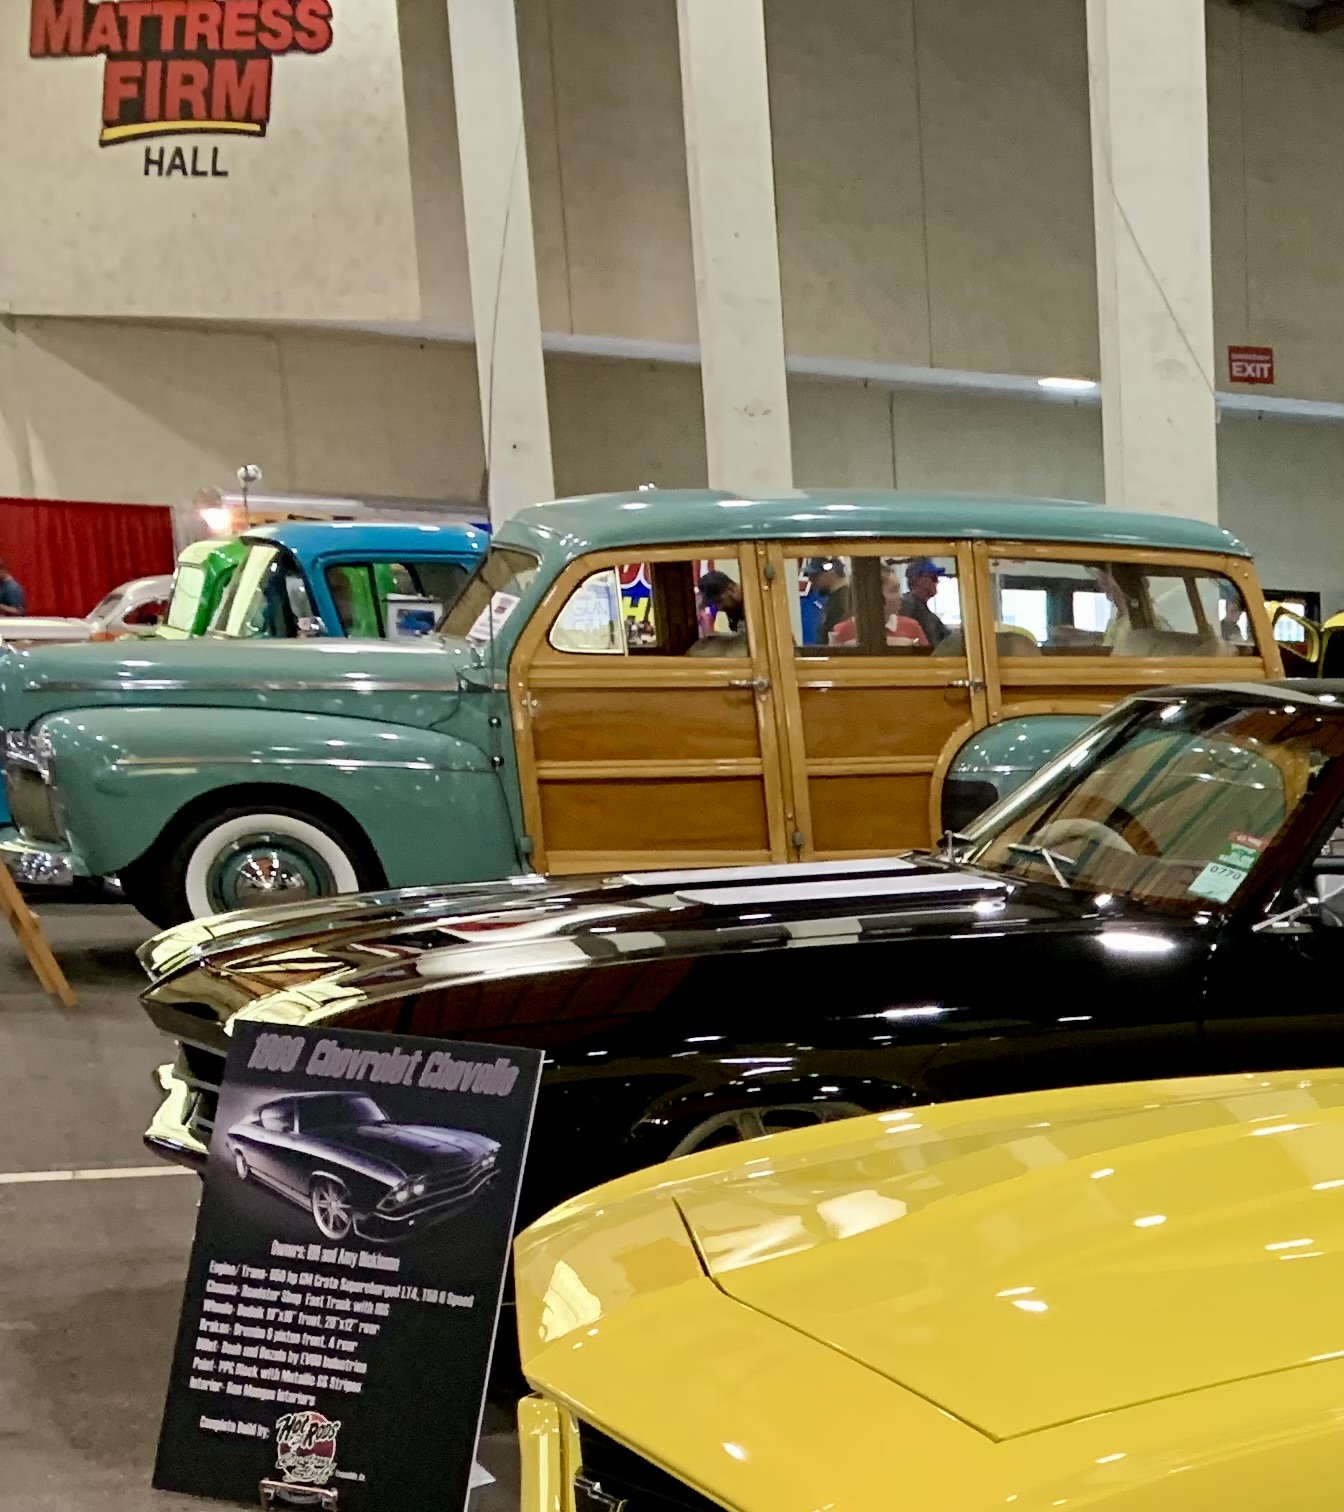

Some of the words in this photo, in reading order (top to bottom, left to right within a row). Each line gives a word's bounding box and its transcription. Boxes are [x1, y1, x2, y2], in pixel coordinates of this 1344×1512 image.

[29, 0, 333, 55] MATTRESS
[102, 58, 271, 123] FIRM
[143, 146, 228, 177] HALL
[1231, 361, 1271, 379] EXIT
[1209, 865, 1242, 881] 0770
